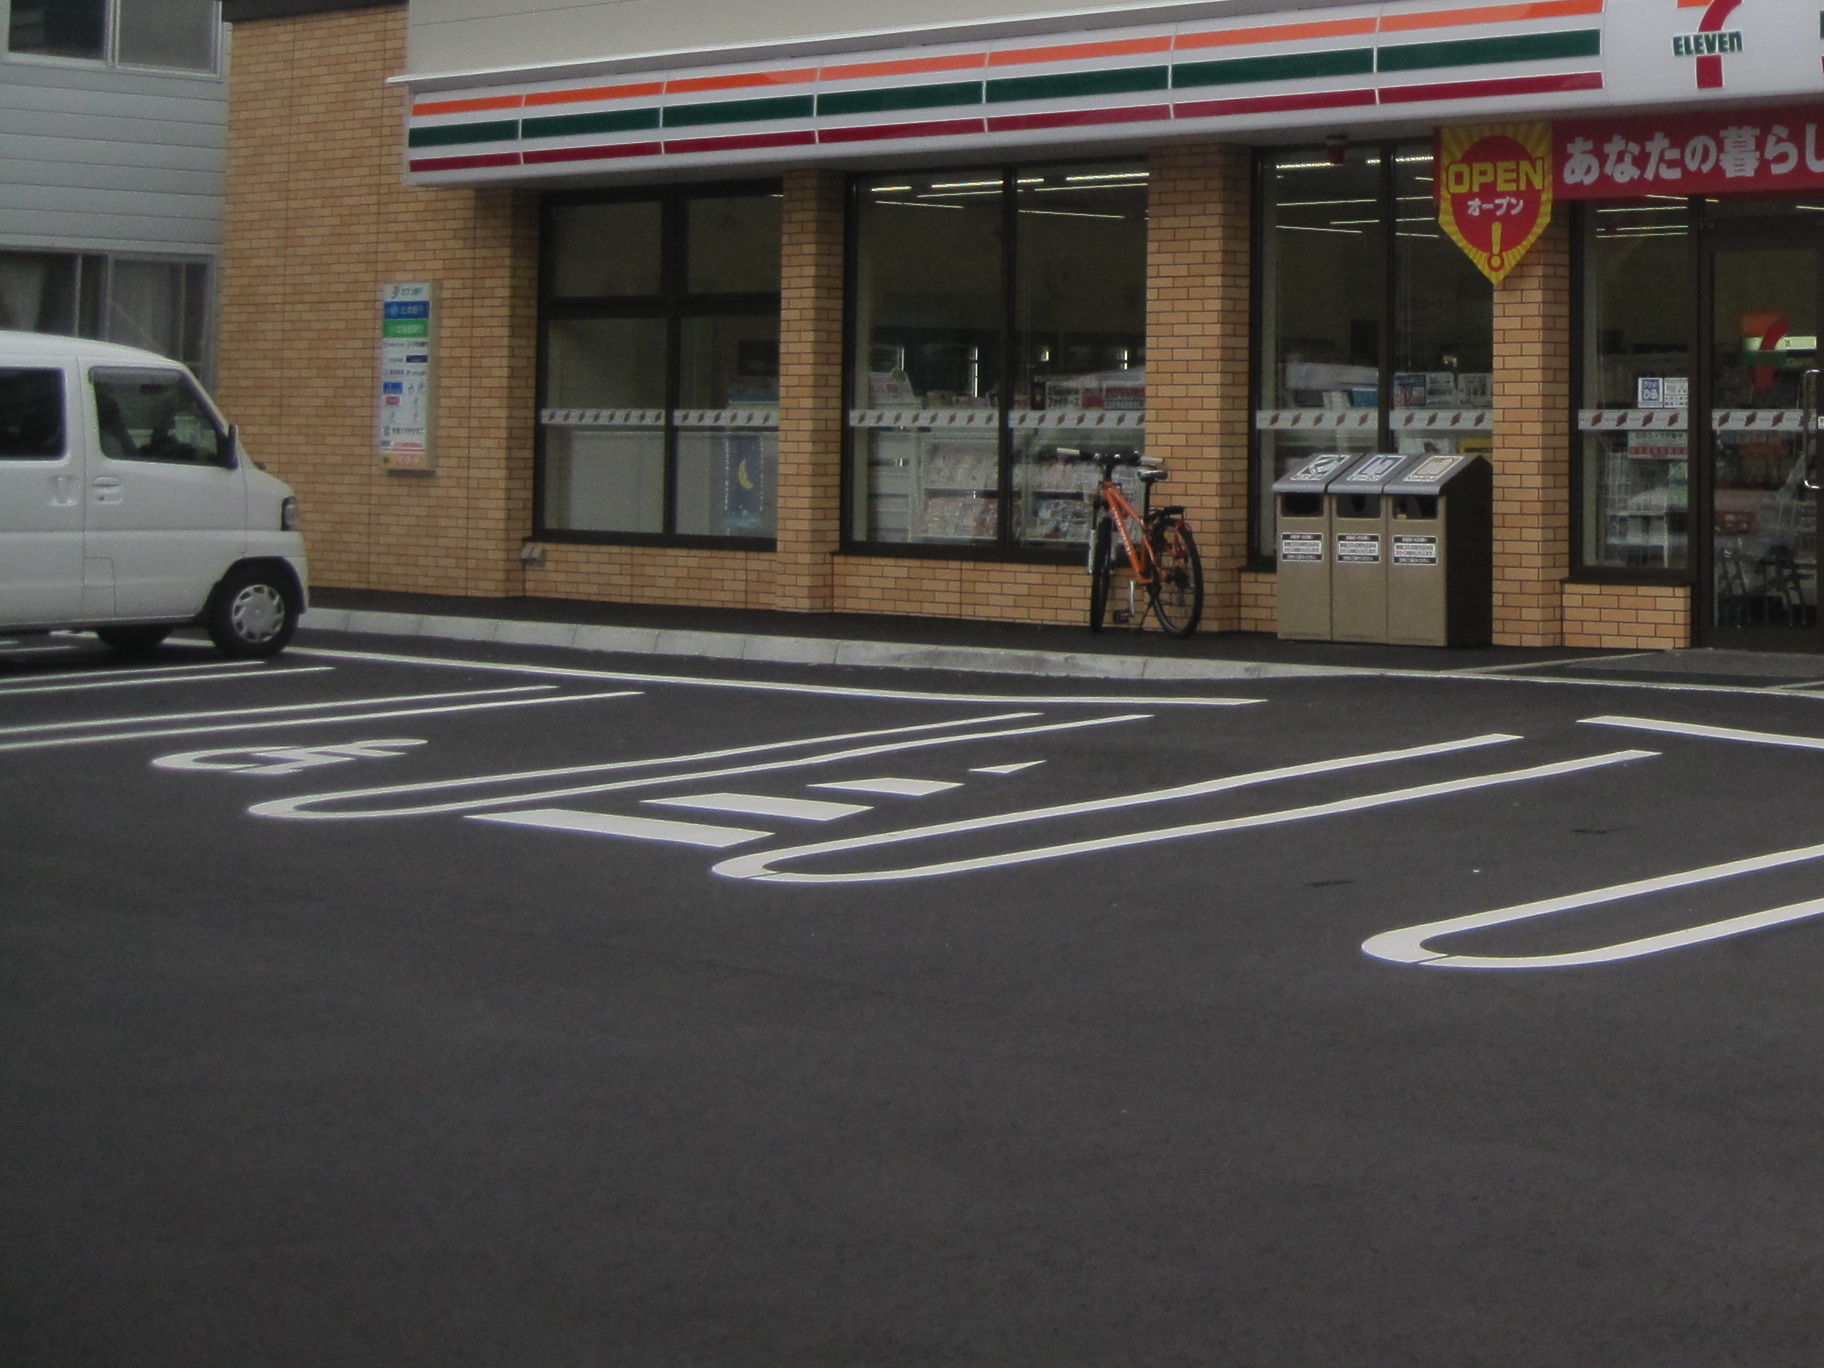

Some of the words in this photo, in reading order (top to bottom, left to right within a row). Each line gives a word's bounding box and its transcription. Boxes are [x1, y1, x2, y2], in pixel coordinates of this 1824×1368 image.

[1673, 31, 1743, 56] ELEVEn
[1447, 158, 1544, 194] OPEN
[1467, 196, 1524, 216] オープン
